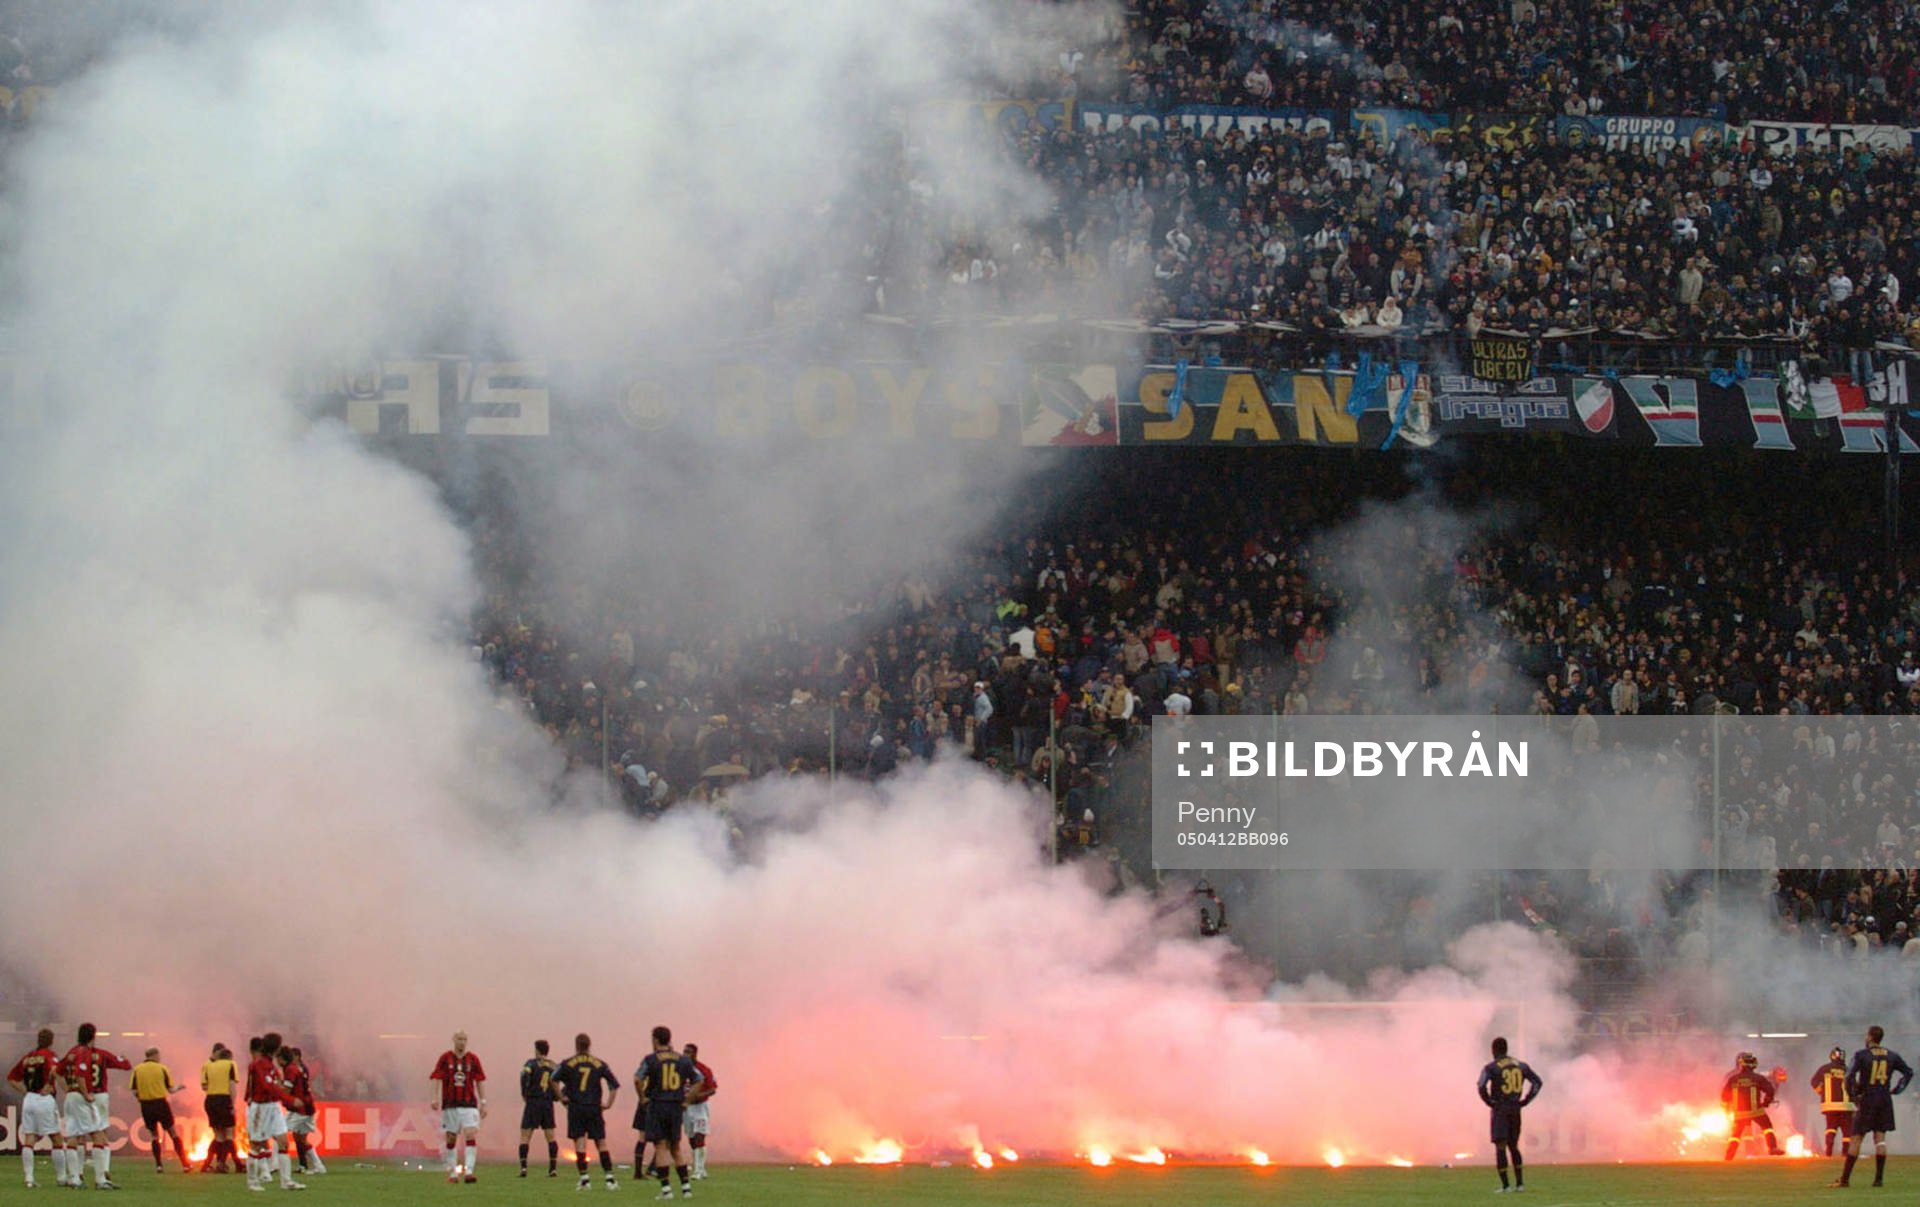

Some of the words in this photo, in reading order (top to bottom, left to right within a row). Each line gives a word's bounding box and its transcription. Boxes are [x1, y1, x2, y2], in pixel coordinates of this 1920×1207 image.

[1605, 118, 1676, 134] GRUPPO
[1471, 339, 1528, 360] ULTRAS
[714, 363, 1001, 440] BOYS
[1138, 372, 1360, 444] SAN
[91, 1063, 101, 1088] 3
[539, 1070, 550, 1094] 4
[577, 1066, 592, 1092] 7
[661, 1062, 682, 1092] 16
[1501, 1067, 1523, 1095] 30
[1869, 1059, 1889, 1086] 14
